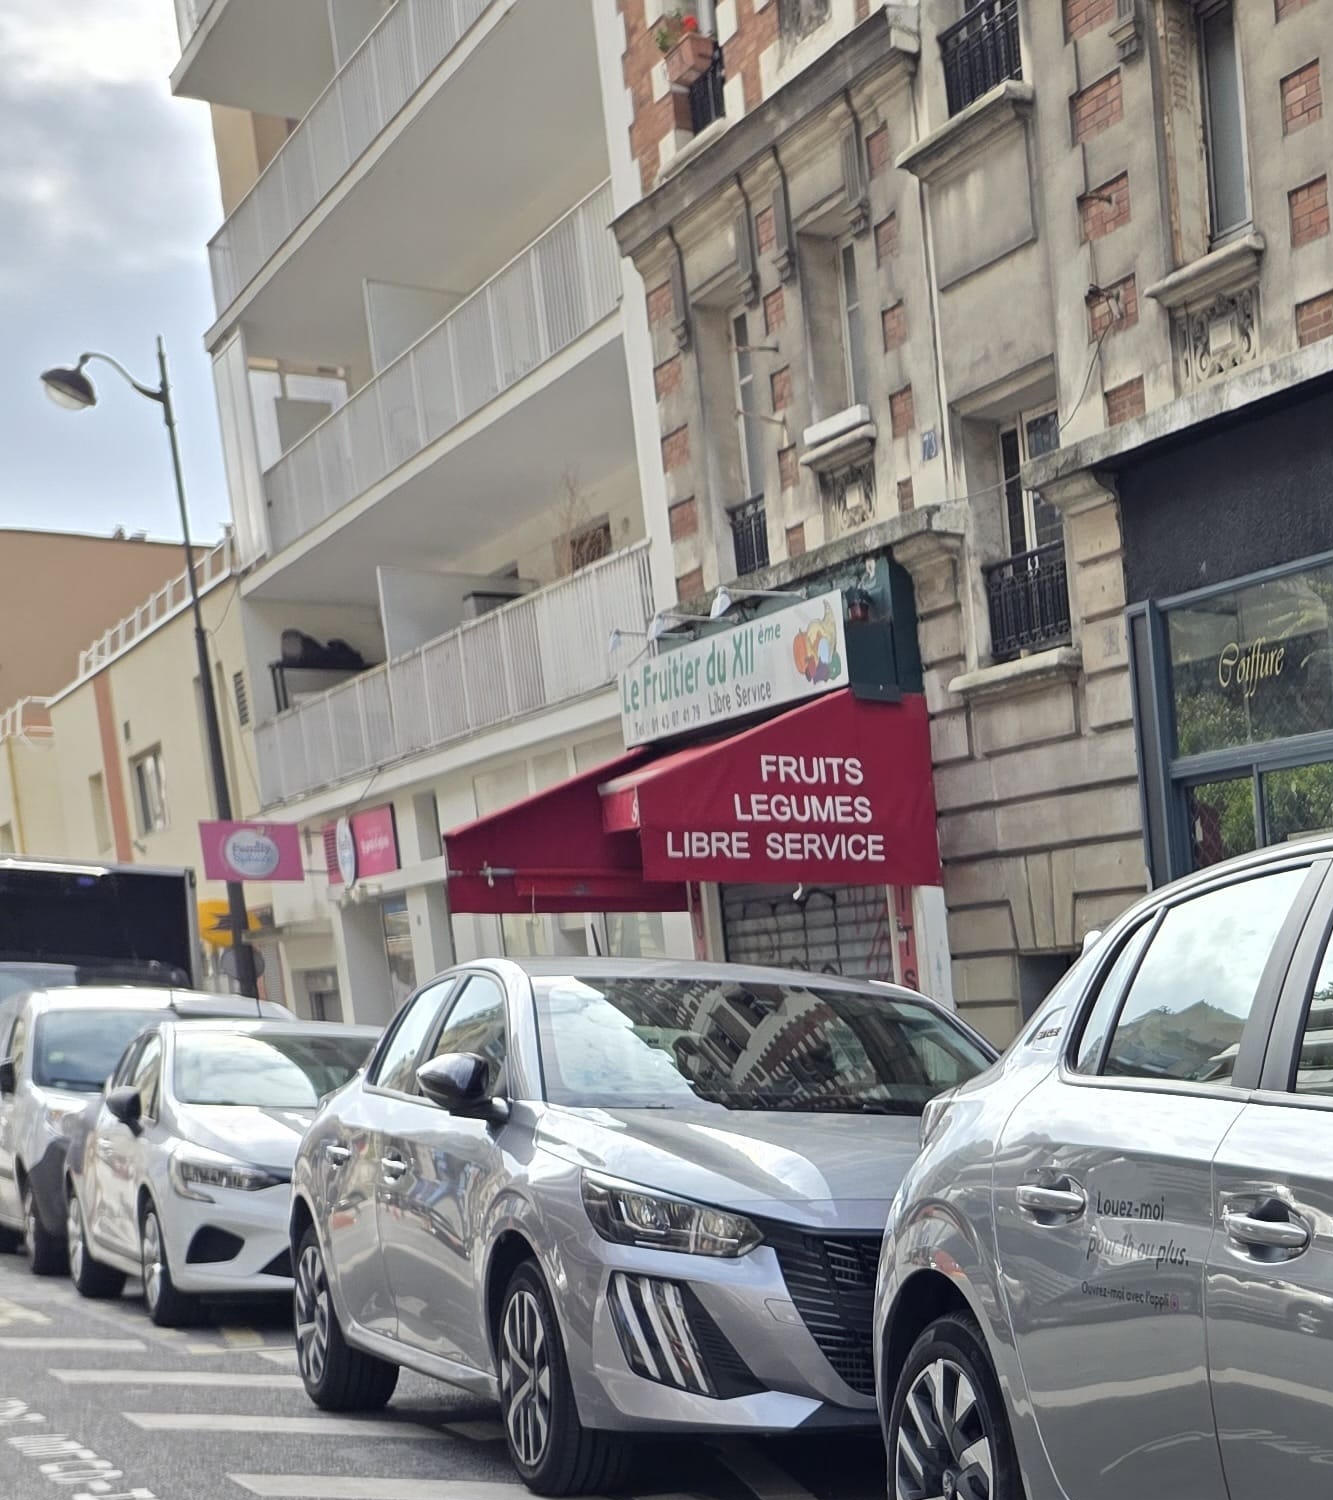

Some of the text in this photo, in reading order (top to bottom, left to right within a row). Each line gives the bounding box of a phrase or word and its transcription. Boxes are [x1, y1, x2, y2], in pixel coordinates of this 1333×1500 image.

[623, 672, 639, 714] Le
[643, 653, 701, 708] Fruitier
[706, 640, 727, 687] du
[1218, 637, 1285, 697] Coiffure
[707, 681, 772, 716] Libre Service
[760, 754, 864, 786] FRUITS
[734, 793, 873, 823] LEGUMES
[666, 831, 886, 861] LIBRE SERVICE
[1096, 1191, 1165, 1221] Louez-moi
[1086, 1233, 1189, 1271] pour 1h ou plus.
[1081, 1280, 1125, 1300] Ouvrez-moi
[1126, 1291, 1144, 1304] avec
